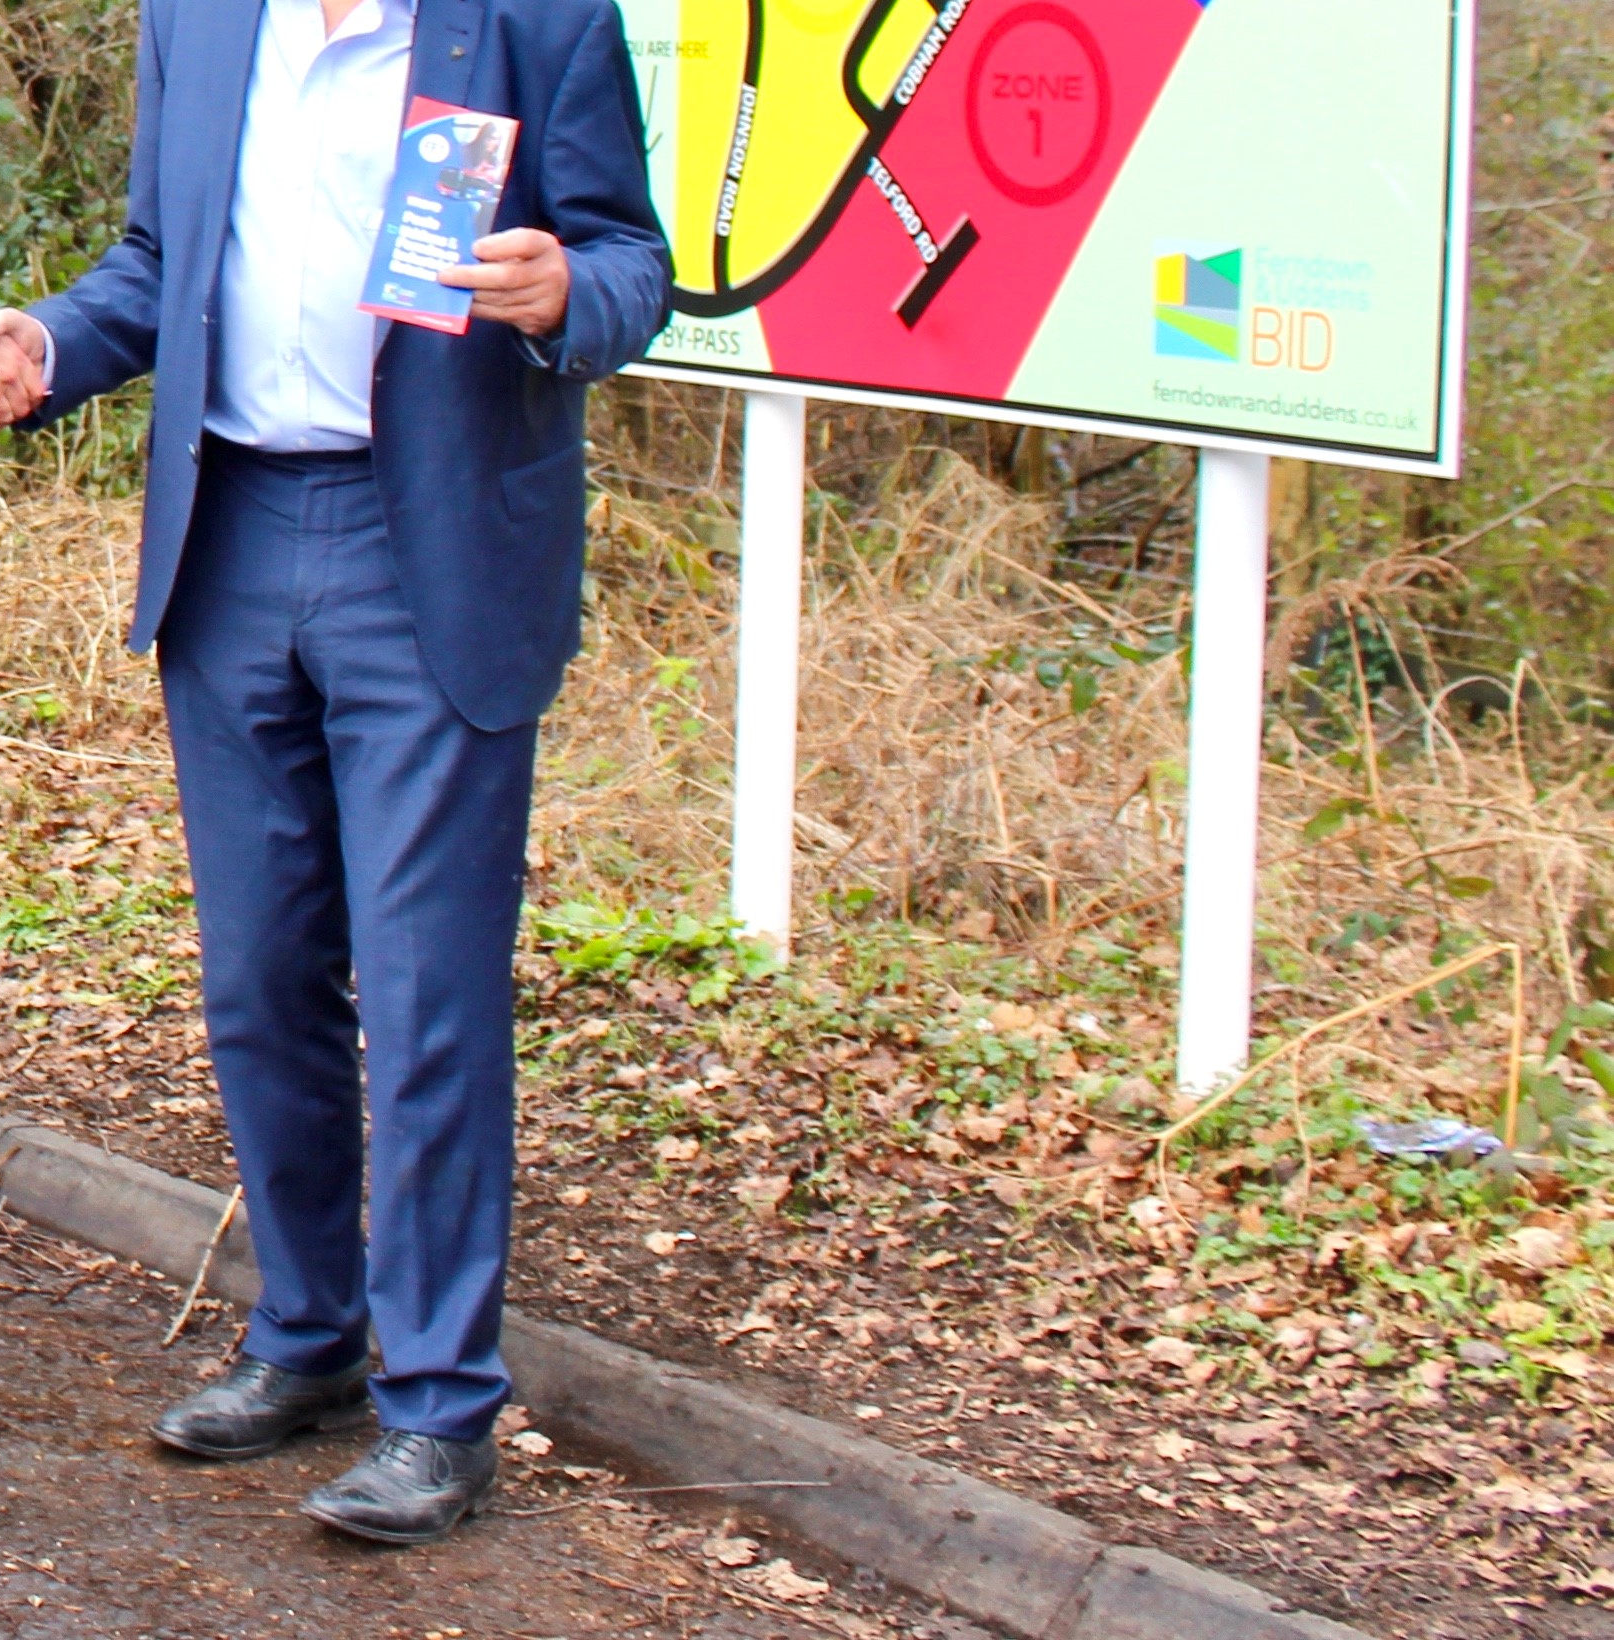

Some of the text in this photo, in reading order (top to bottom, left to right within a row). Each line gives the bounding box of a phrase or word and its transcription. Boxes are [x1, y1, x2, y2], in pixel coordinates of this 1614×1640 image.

[893, 26, 947, 106] COBHAM
[992, 73, 1083, 101] ZONE
[715, 83, 758, 238] JOHNSON ROAD
[1027, 108, 1042, 158] 1
[865, 155, 939, 264] TELFORD RD
[663, 325, 741, 355] BY-PASS
[1251, 307, 1333, 372] BID
[1152, 379, 1419, 431] ferndownanduddens.co.uk
